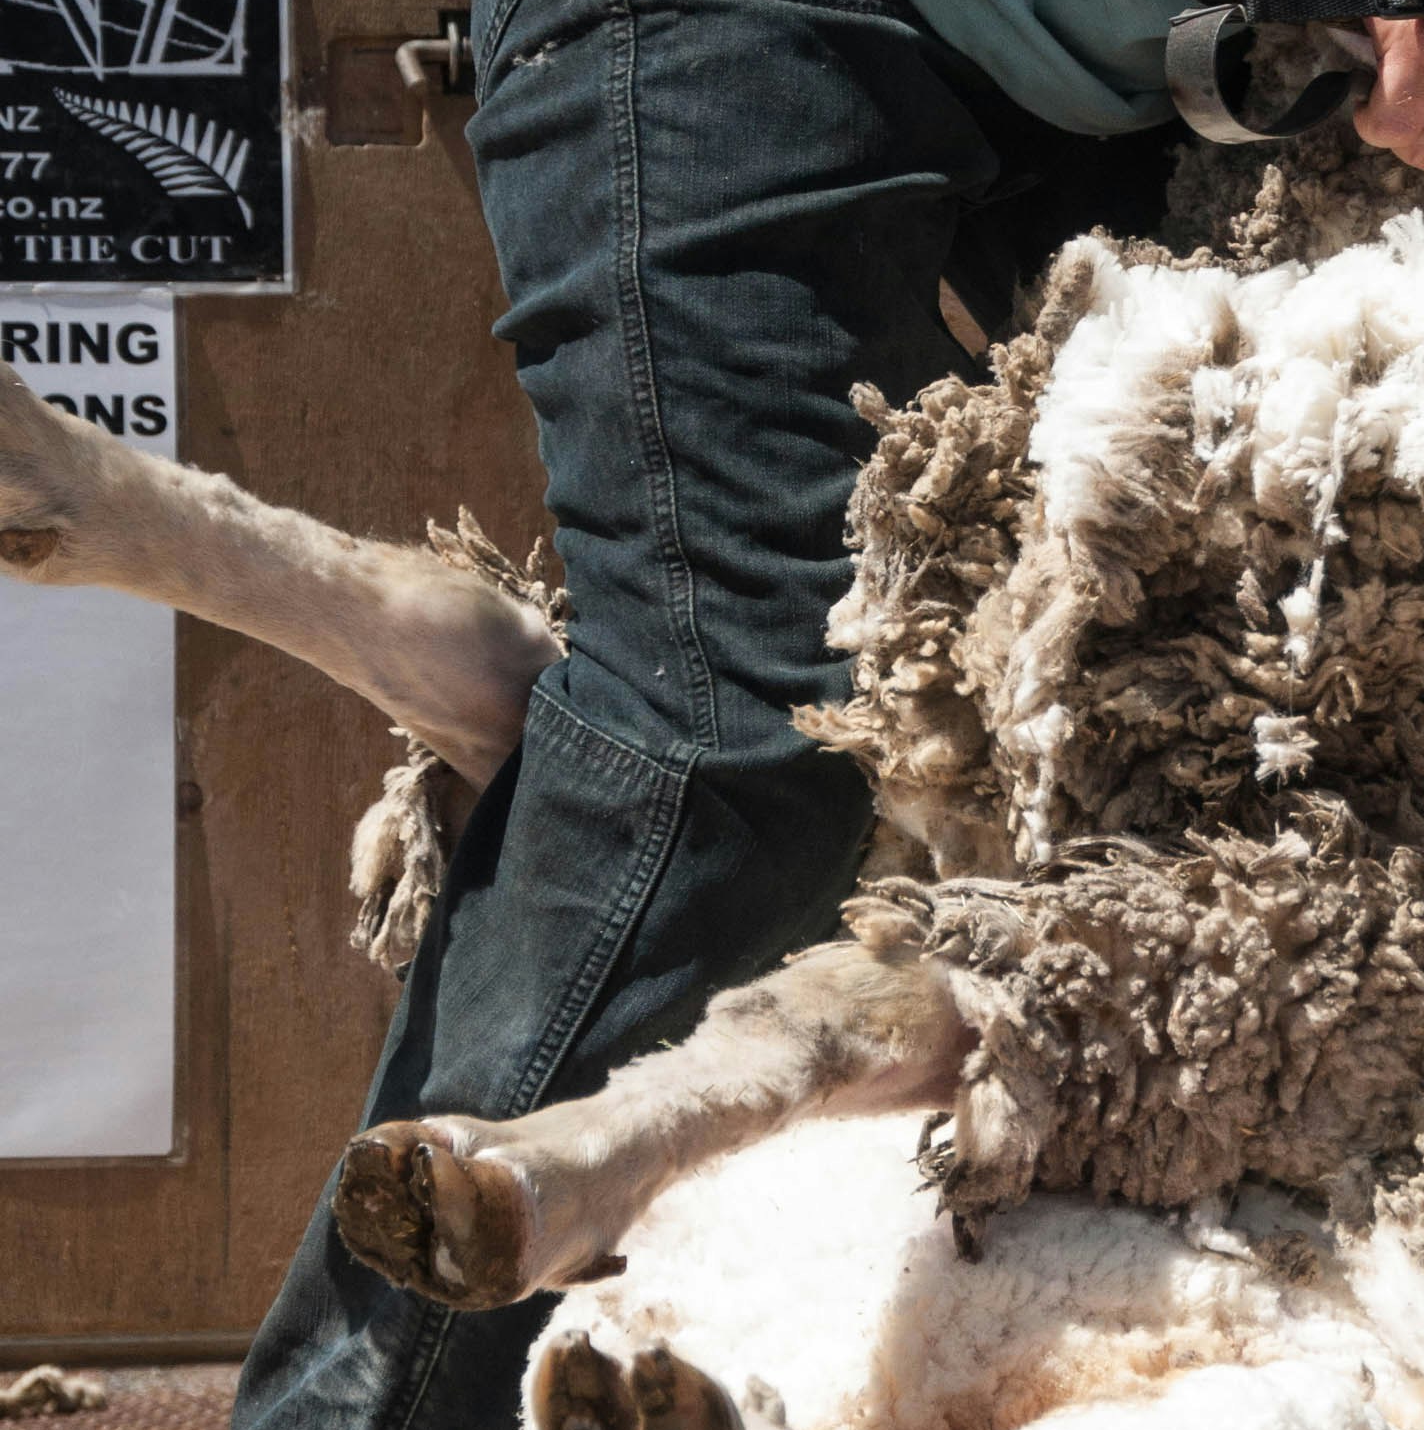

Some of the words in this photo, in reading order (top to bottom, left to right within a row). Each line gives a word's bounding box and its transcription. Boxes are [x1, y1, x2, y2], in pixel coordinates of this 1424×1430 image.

[0, 196, 104, 220] o.nz
[14, 234, 117, 264] THE
[130, 234, 232, 264] CUT
[1, 321, 159, 366] RING
